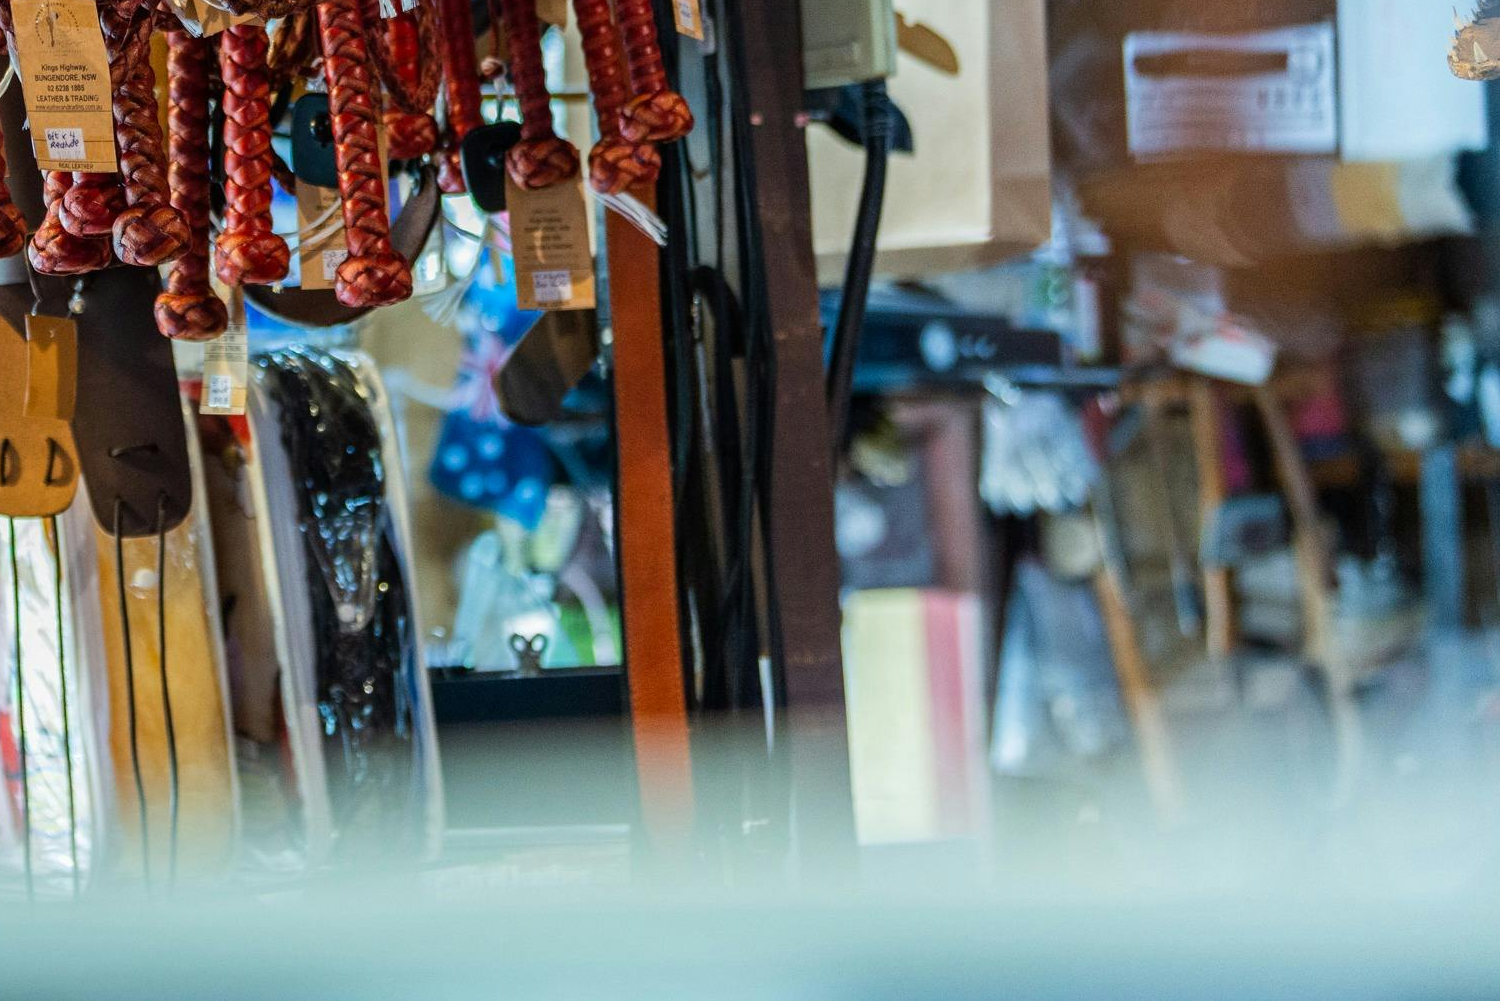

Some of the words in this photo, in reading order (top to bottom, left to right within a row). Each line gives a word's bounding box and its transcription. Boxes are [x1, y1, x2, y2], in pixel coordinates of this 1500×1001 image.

[41, 64, 59, 72] Kings
[60, 63, 88, 72] Highway,
[82, 73, 97, 81] NSW
[36, 94, 64, 102] LEATHER
[71, 94, 99, 102] TRADING
